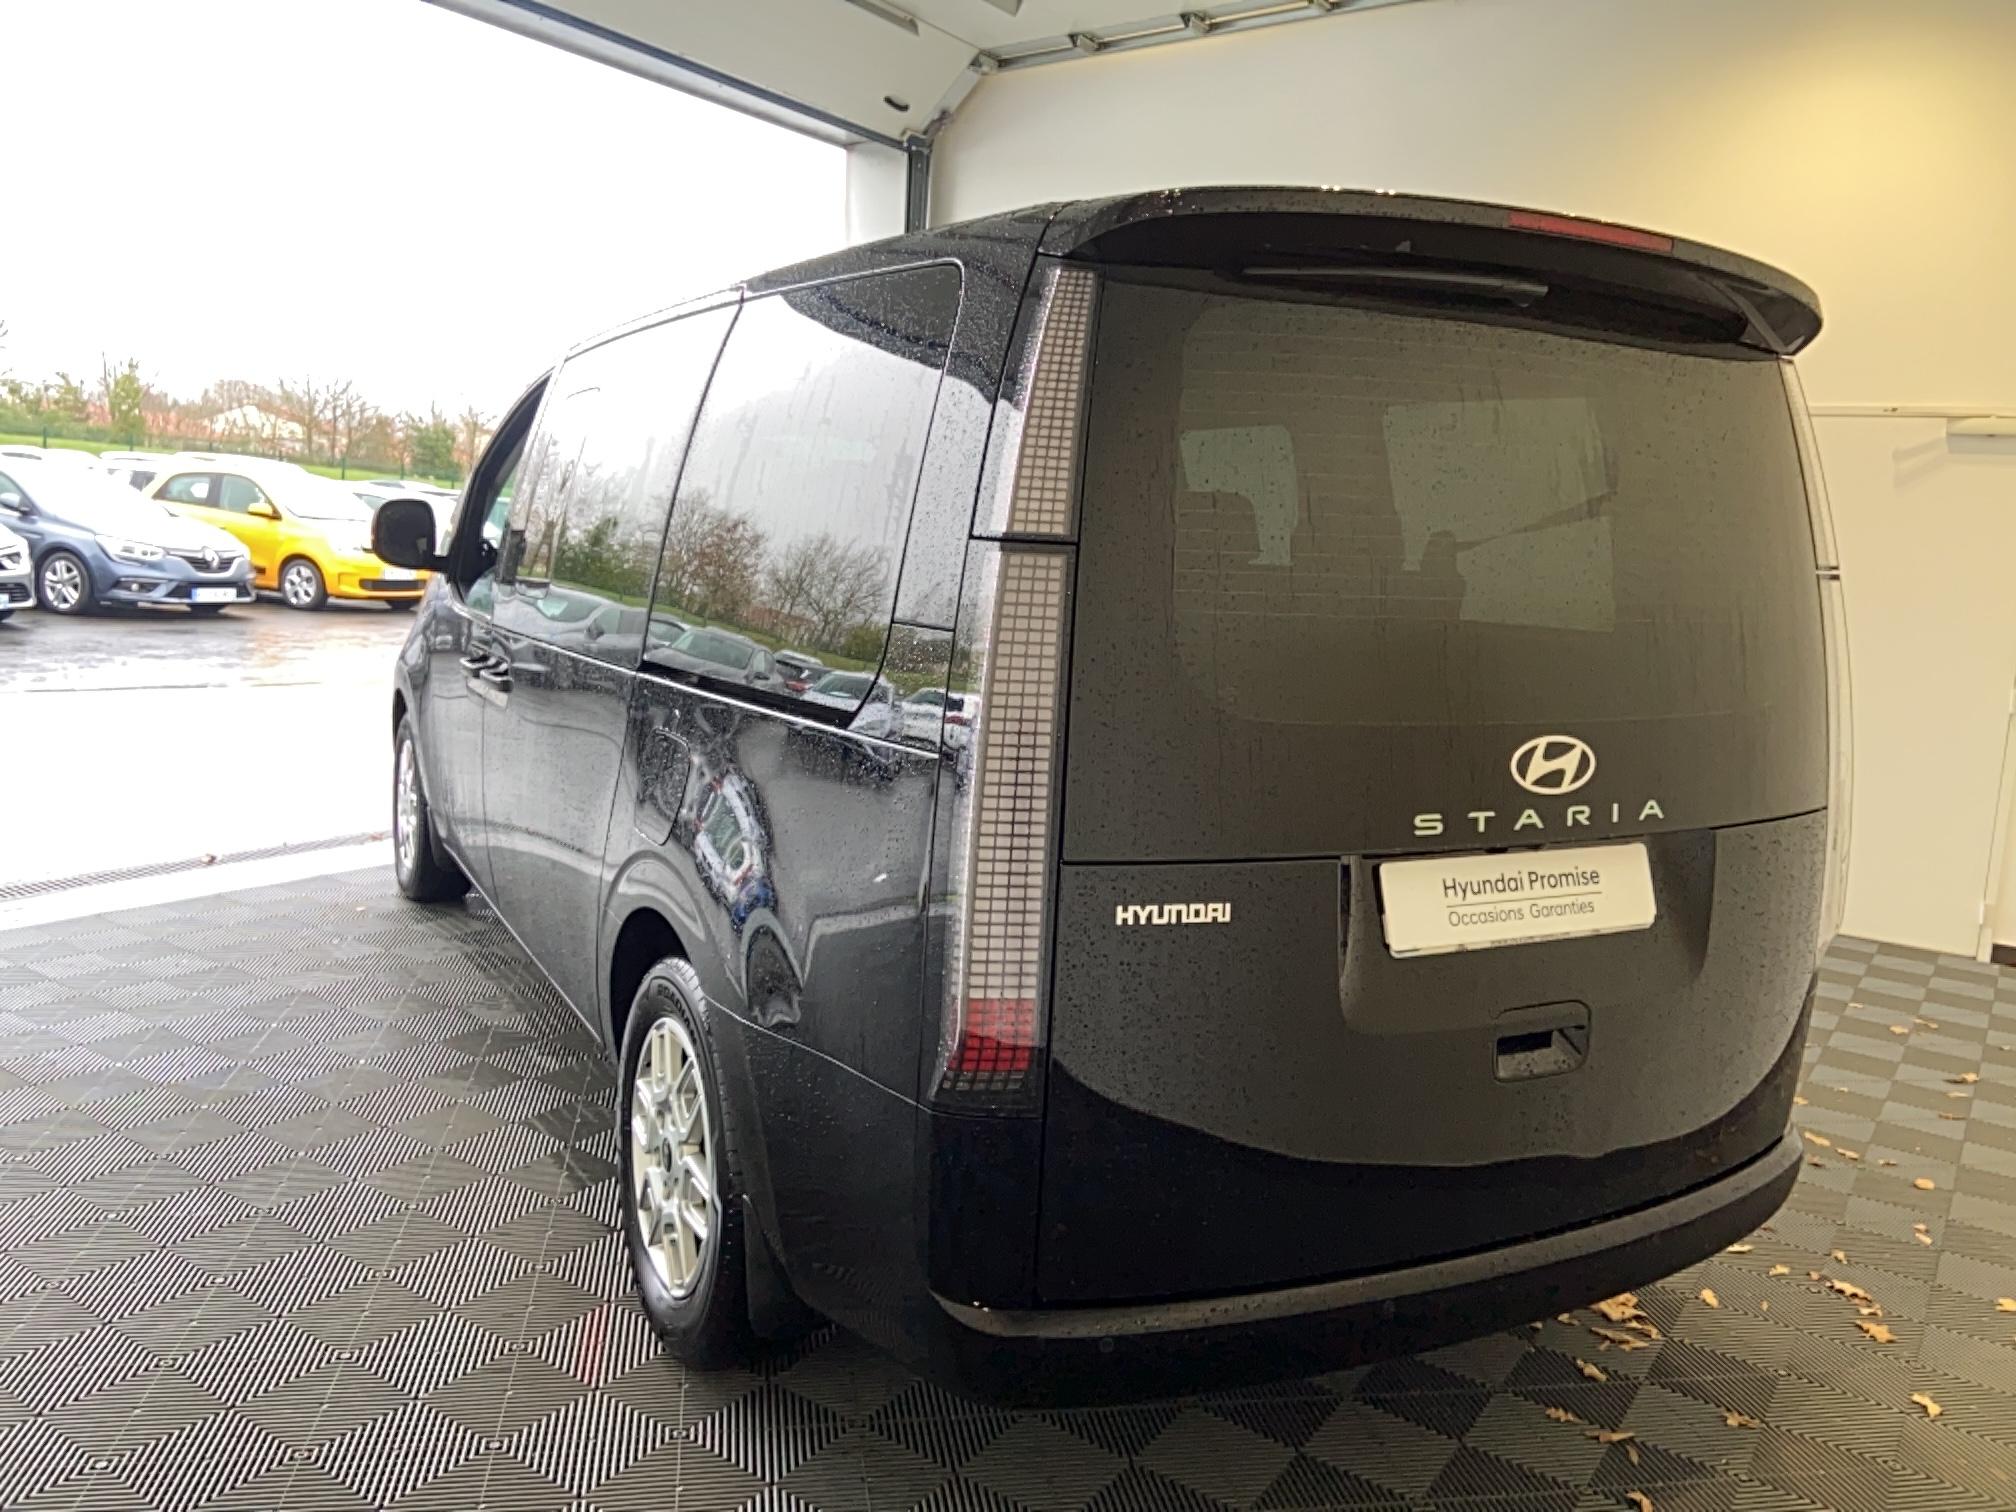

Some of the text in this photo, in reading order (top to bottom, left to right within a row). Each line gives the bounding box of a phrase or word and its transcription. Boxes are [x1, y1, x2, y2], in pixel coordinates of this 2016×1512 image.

[1413, 799, 1665, 837] STARIA
[1442, 865, 1601, 901] Hyundai Promise
[1115, 902, 1231, 926] HYUNDAI
[1448, 897, 1595, 928] Occasions Garanties
